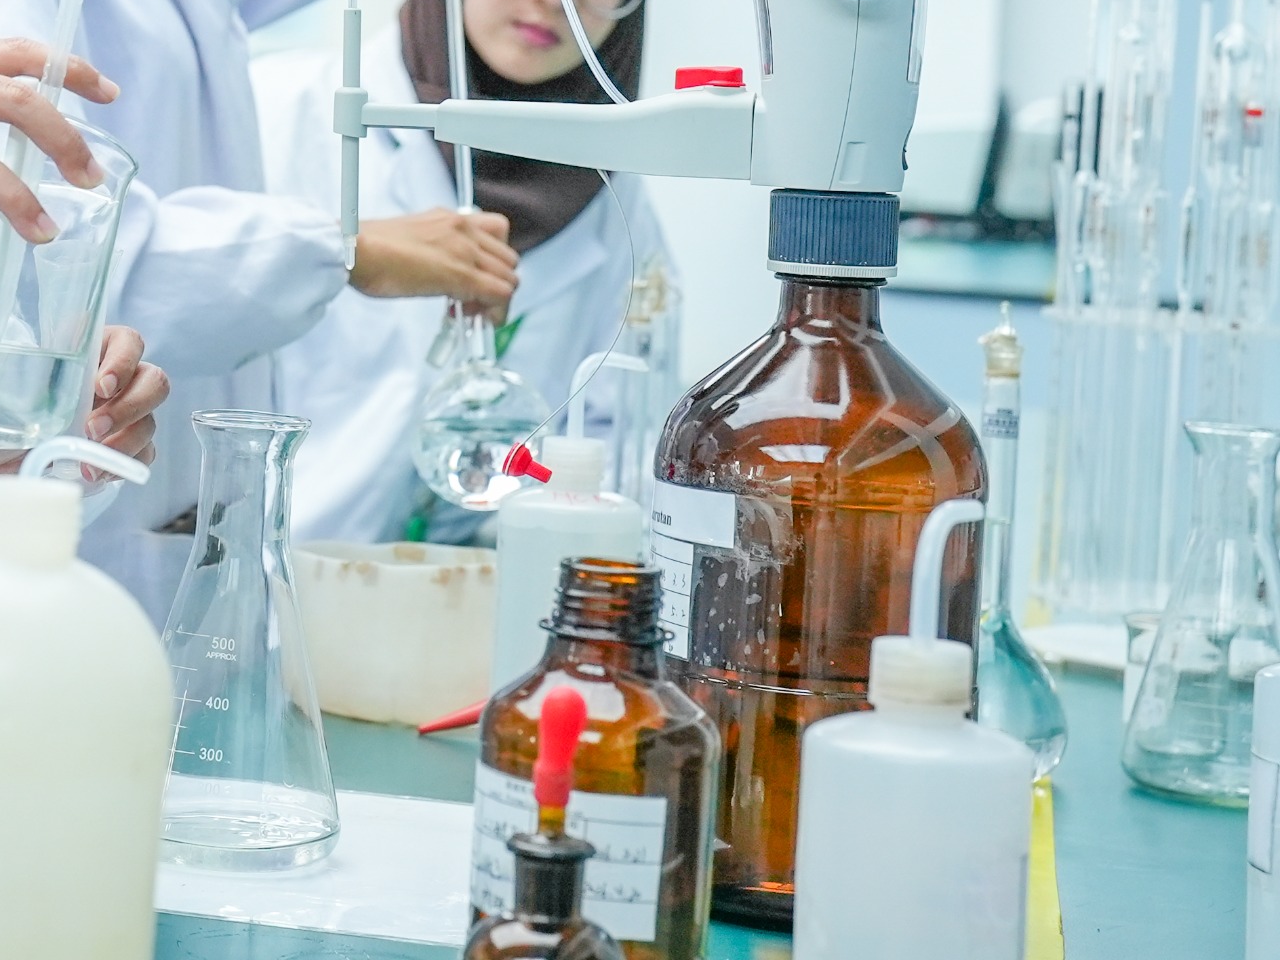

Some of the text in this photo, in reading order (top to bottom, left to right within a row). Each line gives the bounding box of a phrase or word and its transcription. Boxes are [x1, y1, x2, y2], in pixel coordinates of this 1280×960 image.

[211, 637, 236, 652] 500
[205, 651, 237, 662] APPROX
[205, 697, 230, 711] 400
[198, 748, 224, 762] 300
